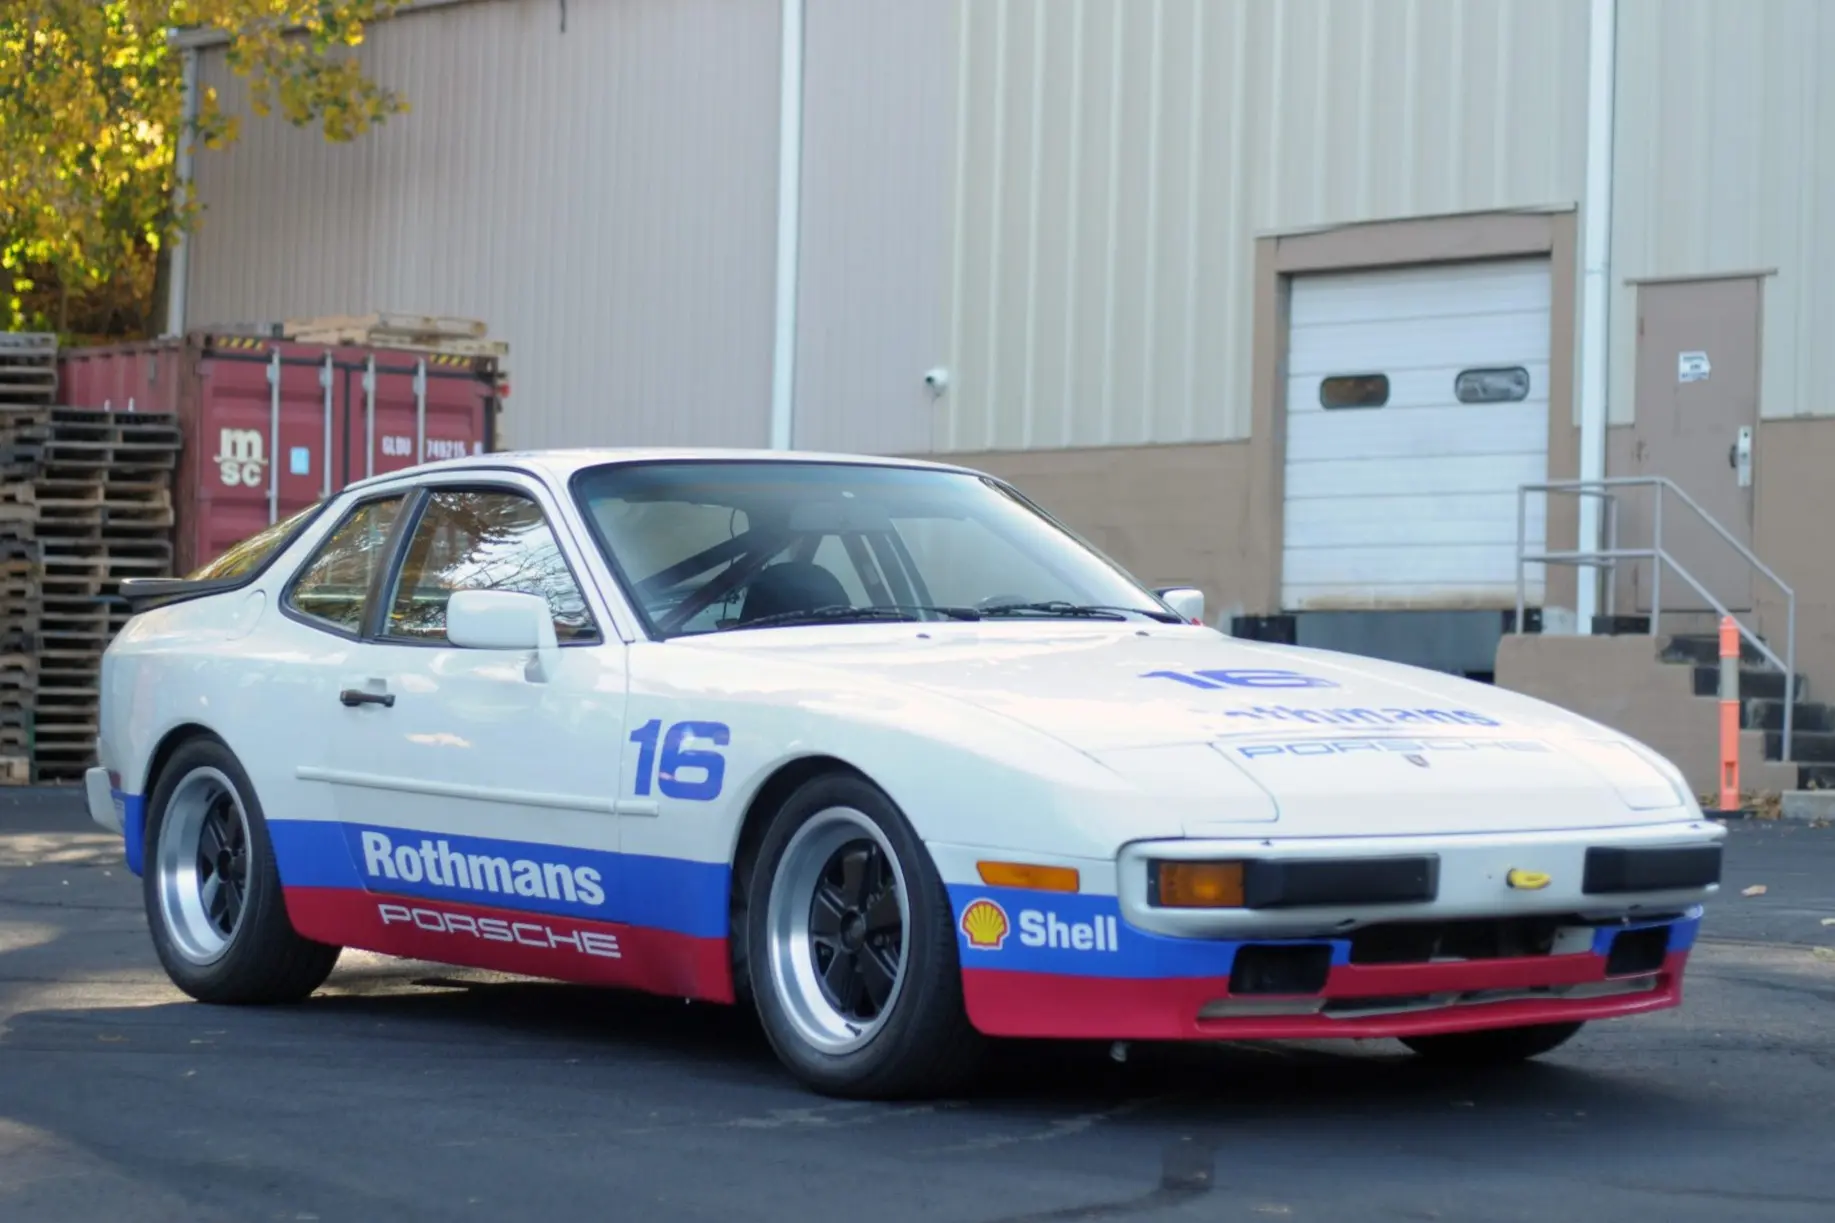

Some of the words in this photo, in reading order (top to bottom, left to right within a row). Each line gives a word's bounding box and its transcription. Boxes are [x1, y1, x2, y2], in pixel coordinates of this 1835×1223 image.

[1137, 669, 1340, 690] 16
[629, 719, 731, 801] 16
[1236, 738, 1552, 760] PORSCHE
[361, 831, 605, 906] Rothmans
[377, 903, 622, 959] PORSCHE
[1019, 908, 1119, 952] Shell
